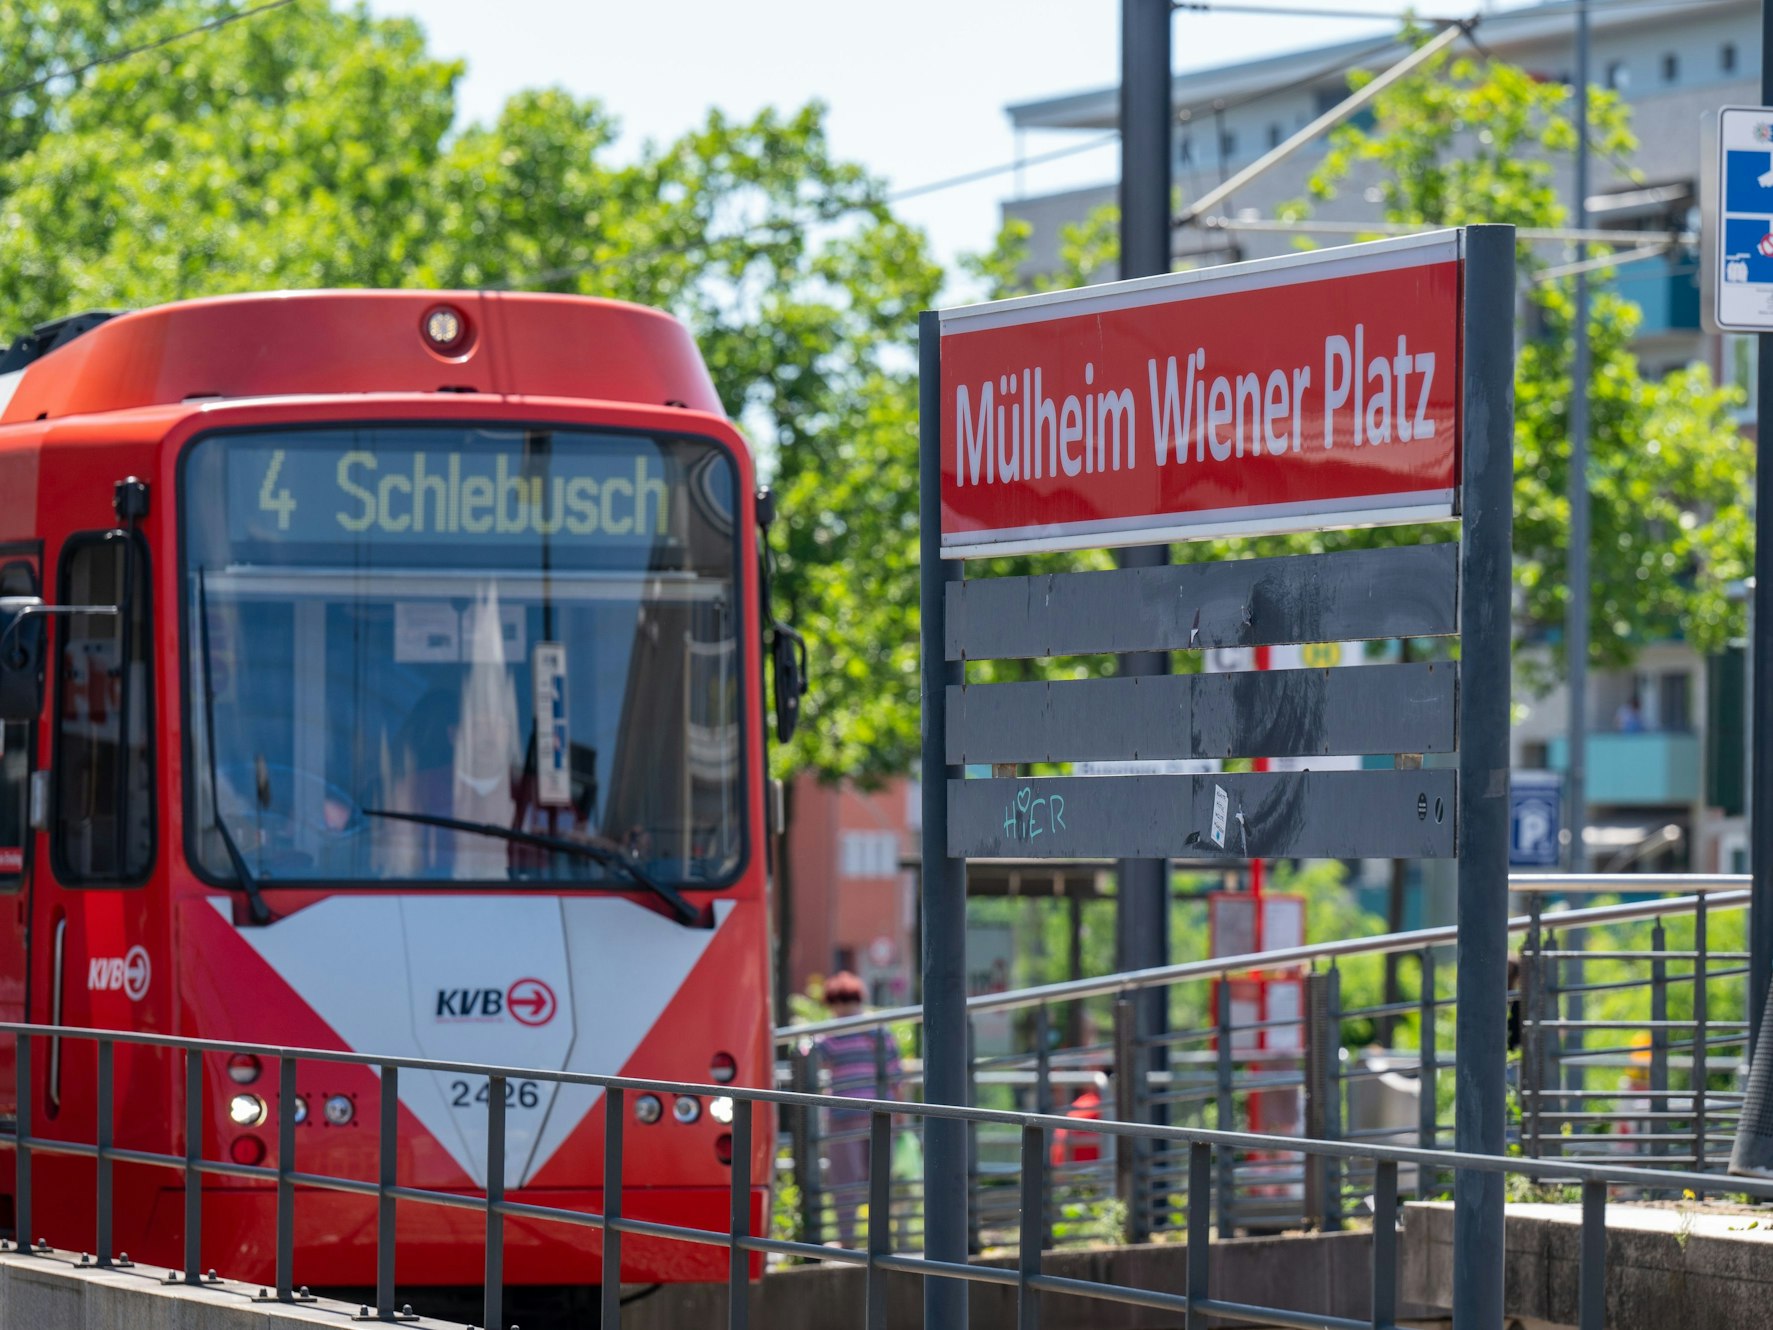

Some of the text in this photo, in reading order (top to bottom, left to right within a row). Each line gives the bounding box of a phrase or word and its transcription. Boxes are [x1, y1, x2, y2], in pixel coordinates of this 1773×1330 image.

[955, 323, 1436, 488] Mülheim Wiener Platz
[258, 449, 669, 536] 4 Schlebusch
[87, 957, 124, 991] KVB
[435, 988, 504, 1017] KVB
